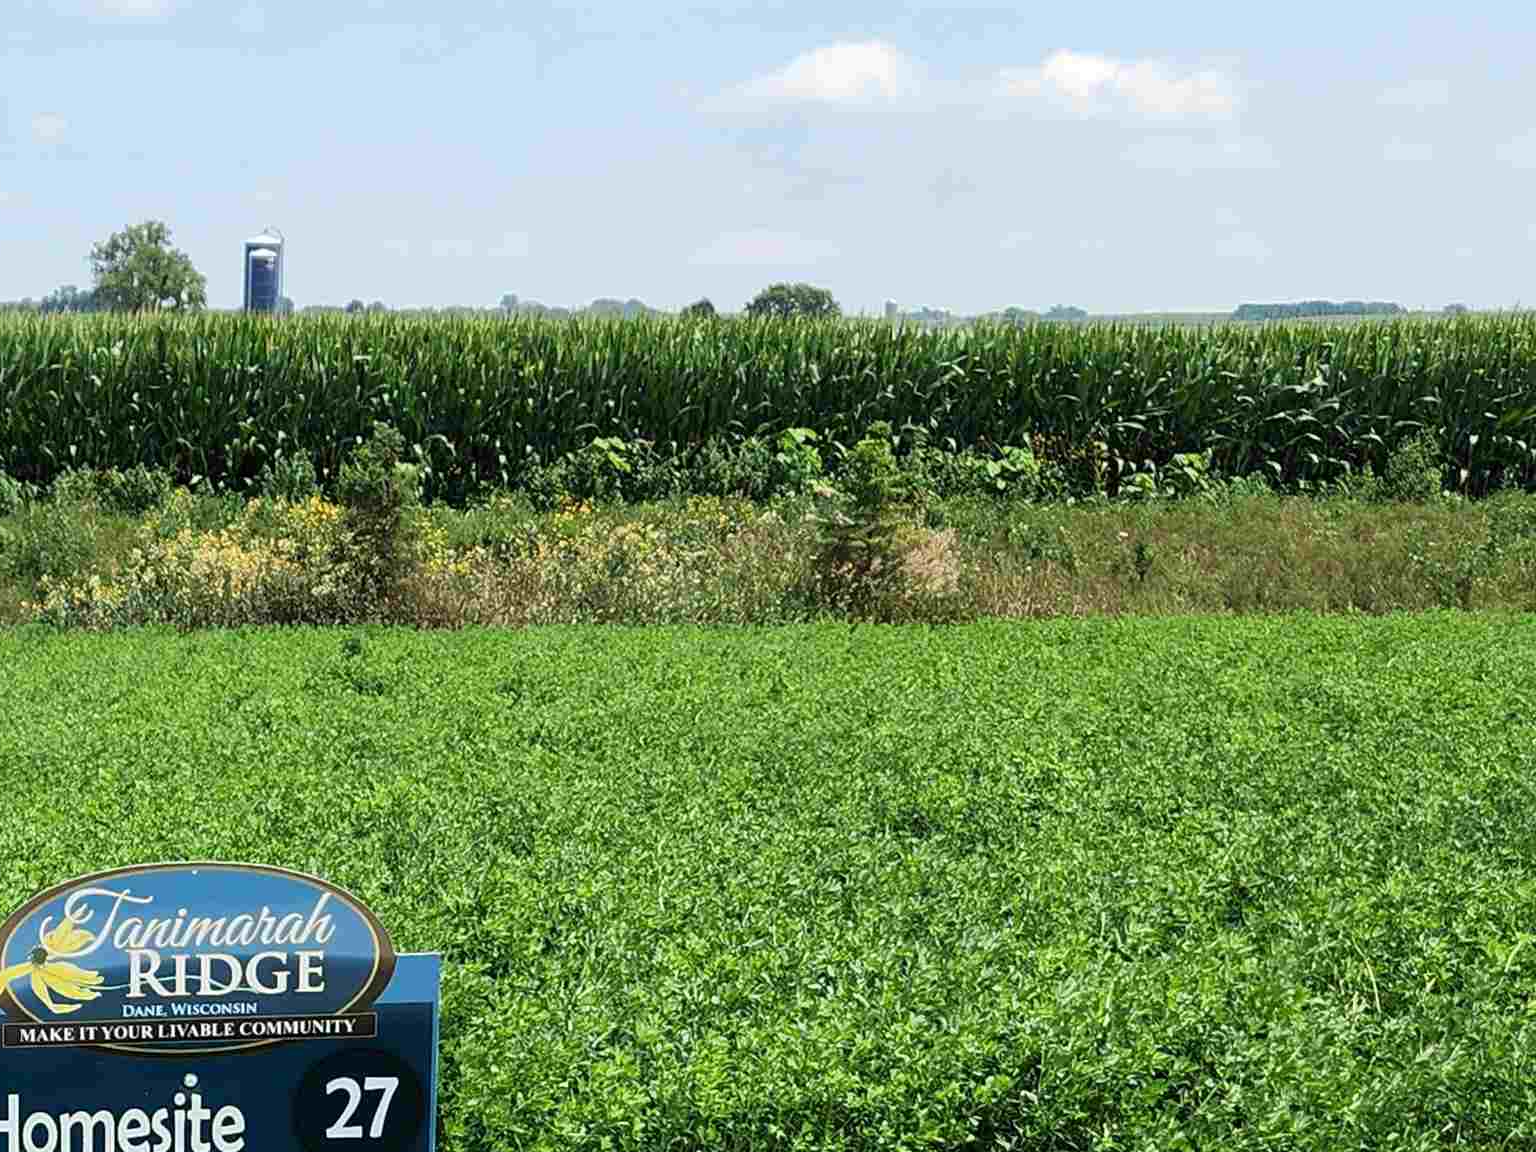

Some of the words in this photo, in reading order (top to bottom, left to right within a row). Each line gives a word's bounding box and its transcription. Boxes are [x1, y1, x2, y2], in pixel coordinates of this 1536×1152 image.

[41, 887, 336, 955] Tanimarah
[125, 950, 325, 999] RIDGE
[19, 1027, 73, 1043] MAKE
[78, 1026, 99, 1041] IT
[99, 1025, 155, 1041] YOUR
[158, 1022, 236, 1040] LIVABLE
[239, 1017, 357, 1037] COMMUNITY
[325, 1076, 400, 1139] 27
